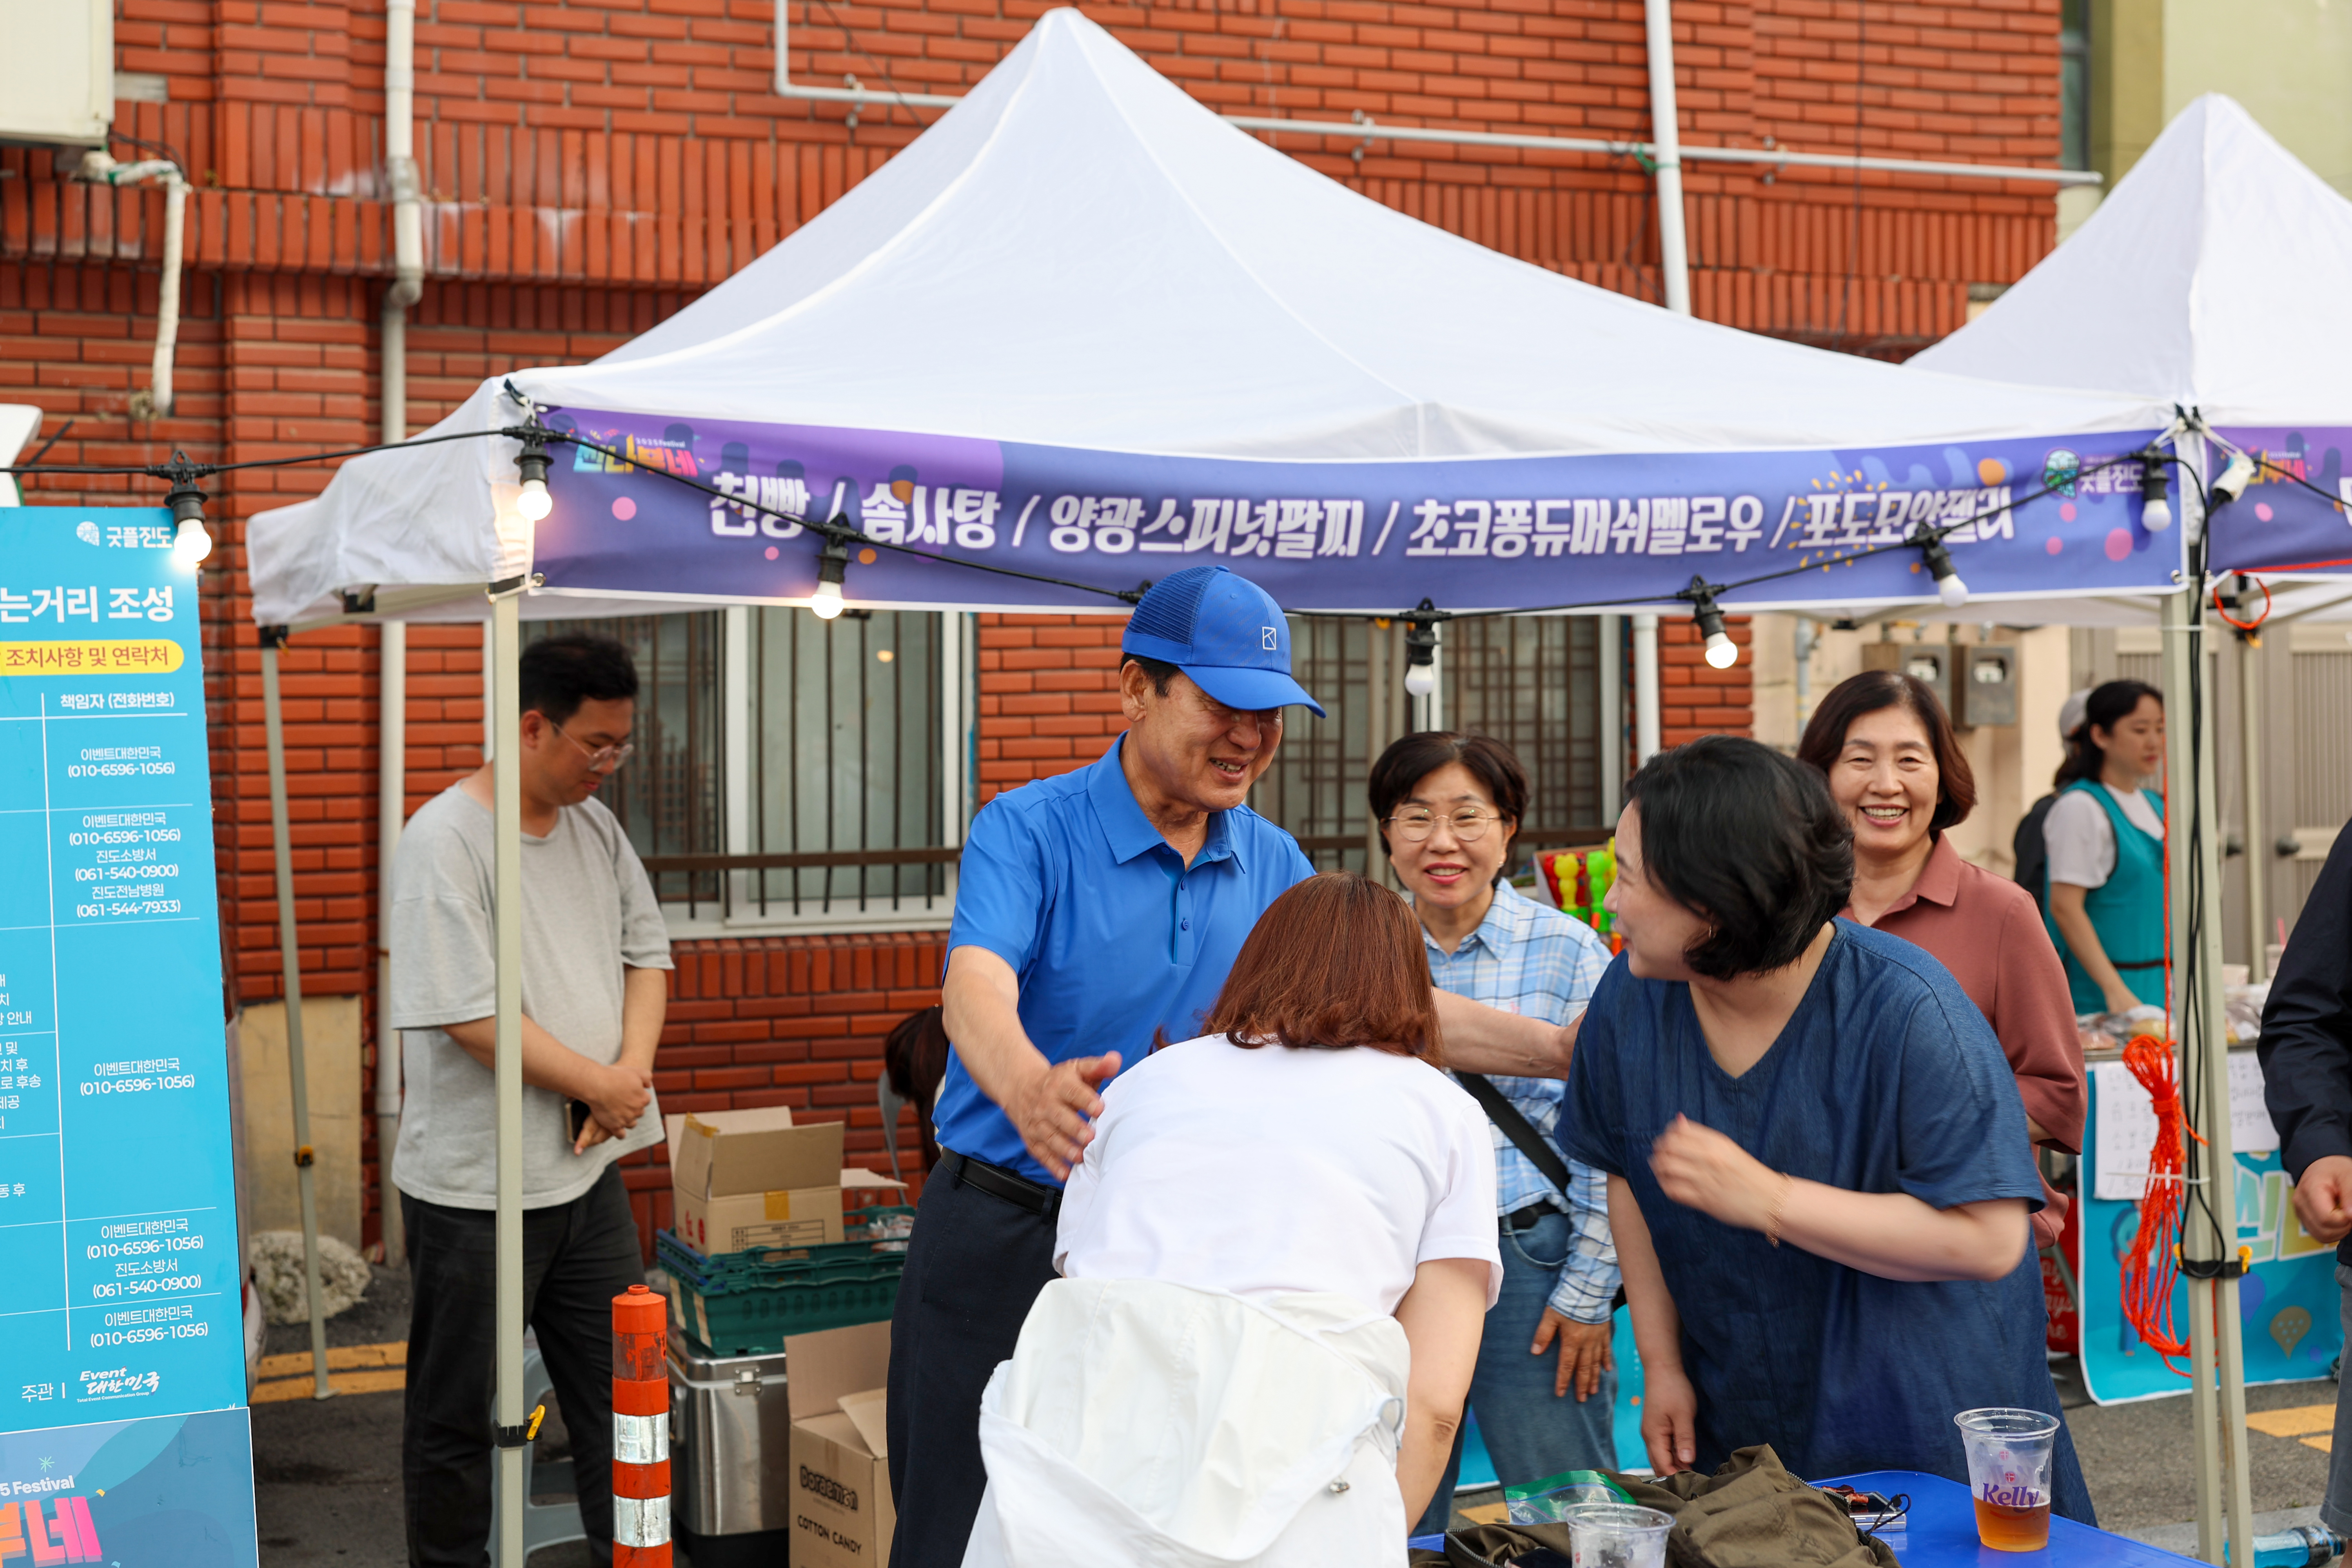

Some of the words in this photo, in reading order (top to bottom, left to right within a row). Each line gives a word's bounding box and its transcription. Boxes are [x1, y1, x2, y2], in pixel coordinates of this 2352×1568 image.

[862, 484, 1000, 548] 솜사탕
[1798, 487, 2014, 547] 포도모양젤리
[107, 526, 172, 548] 굿플진도
[0, 586, 98, 622] 는거리
[108, 586, 174, 622] 조성
[6, 647, 83, 667] 조치사항
[89, 647, 106, 666] 및
[112, 646, 169, 666] 연락처
[60, 694, 105, 709] 책임자
[108, 692, 174, 708] (전화번호)
[81, 746, 161, 760] 이벤트대한민국
[68, 762, 175, 777] (010-6596-1056)
[83, 813, 166, 828] 이벤트대한민국
[69, 828, 180, 846] (010-6596-1056)
[96, 848, 156, 863] 진도소방서
[75, 864, 178, 882] (061-540-0900)
[92, 884, 164, 899] 진도전남병원
[76, 899, 181, 917] (061-544-7933)
[7, 1011, 31, 1025] 안내
[6, 1041, 18, 1055] 및
[16, 1058, 28, 1072] 후
[94, 1058, 180, 1076] 이벤트대한민국
[16, 1074, 41, 1089] 후송
[80, 1074, 194, 1096] (010-6596-1056)
[13, 1182, 25, 1197] 후
[101, 1218, 189, 1239] 이벤트대한민국
[87, 1235, 203, 1259] (010-6596-1056)
[115, 1258, 178, 1277] 진도소방서
[93, 1274, 201, 1299] (061-540-0900)
[105, 1305, 193, 1327] 이벤트대한민국
[91, 1322, 208, 1348] (010-6596-1056)
[80, 1366, 127, 1381] Event
[86, 1372, 160, 1395] 대한민국
[22, 1383, 53, 1403] 주관
[13, 1475, 75, 1495] Festival
[1983, 1483, 2039, 1513] Kelly
[798, 1515, 830, 1541] COTTON
[833, 1532, 862, 1555] CANDY
